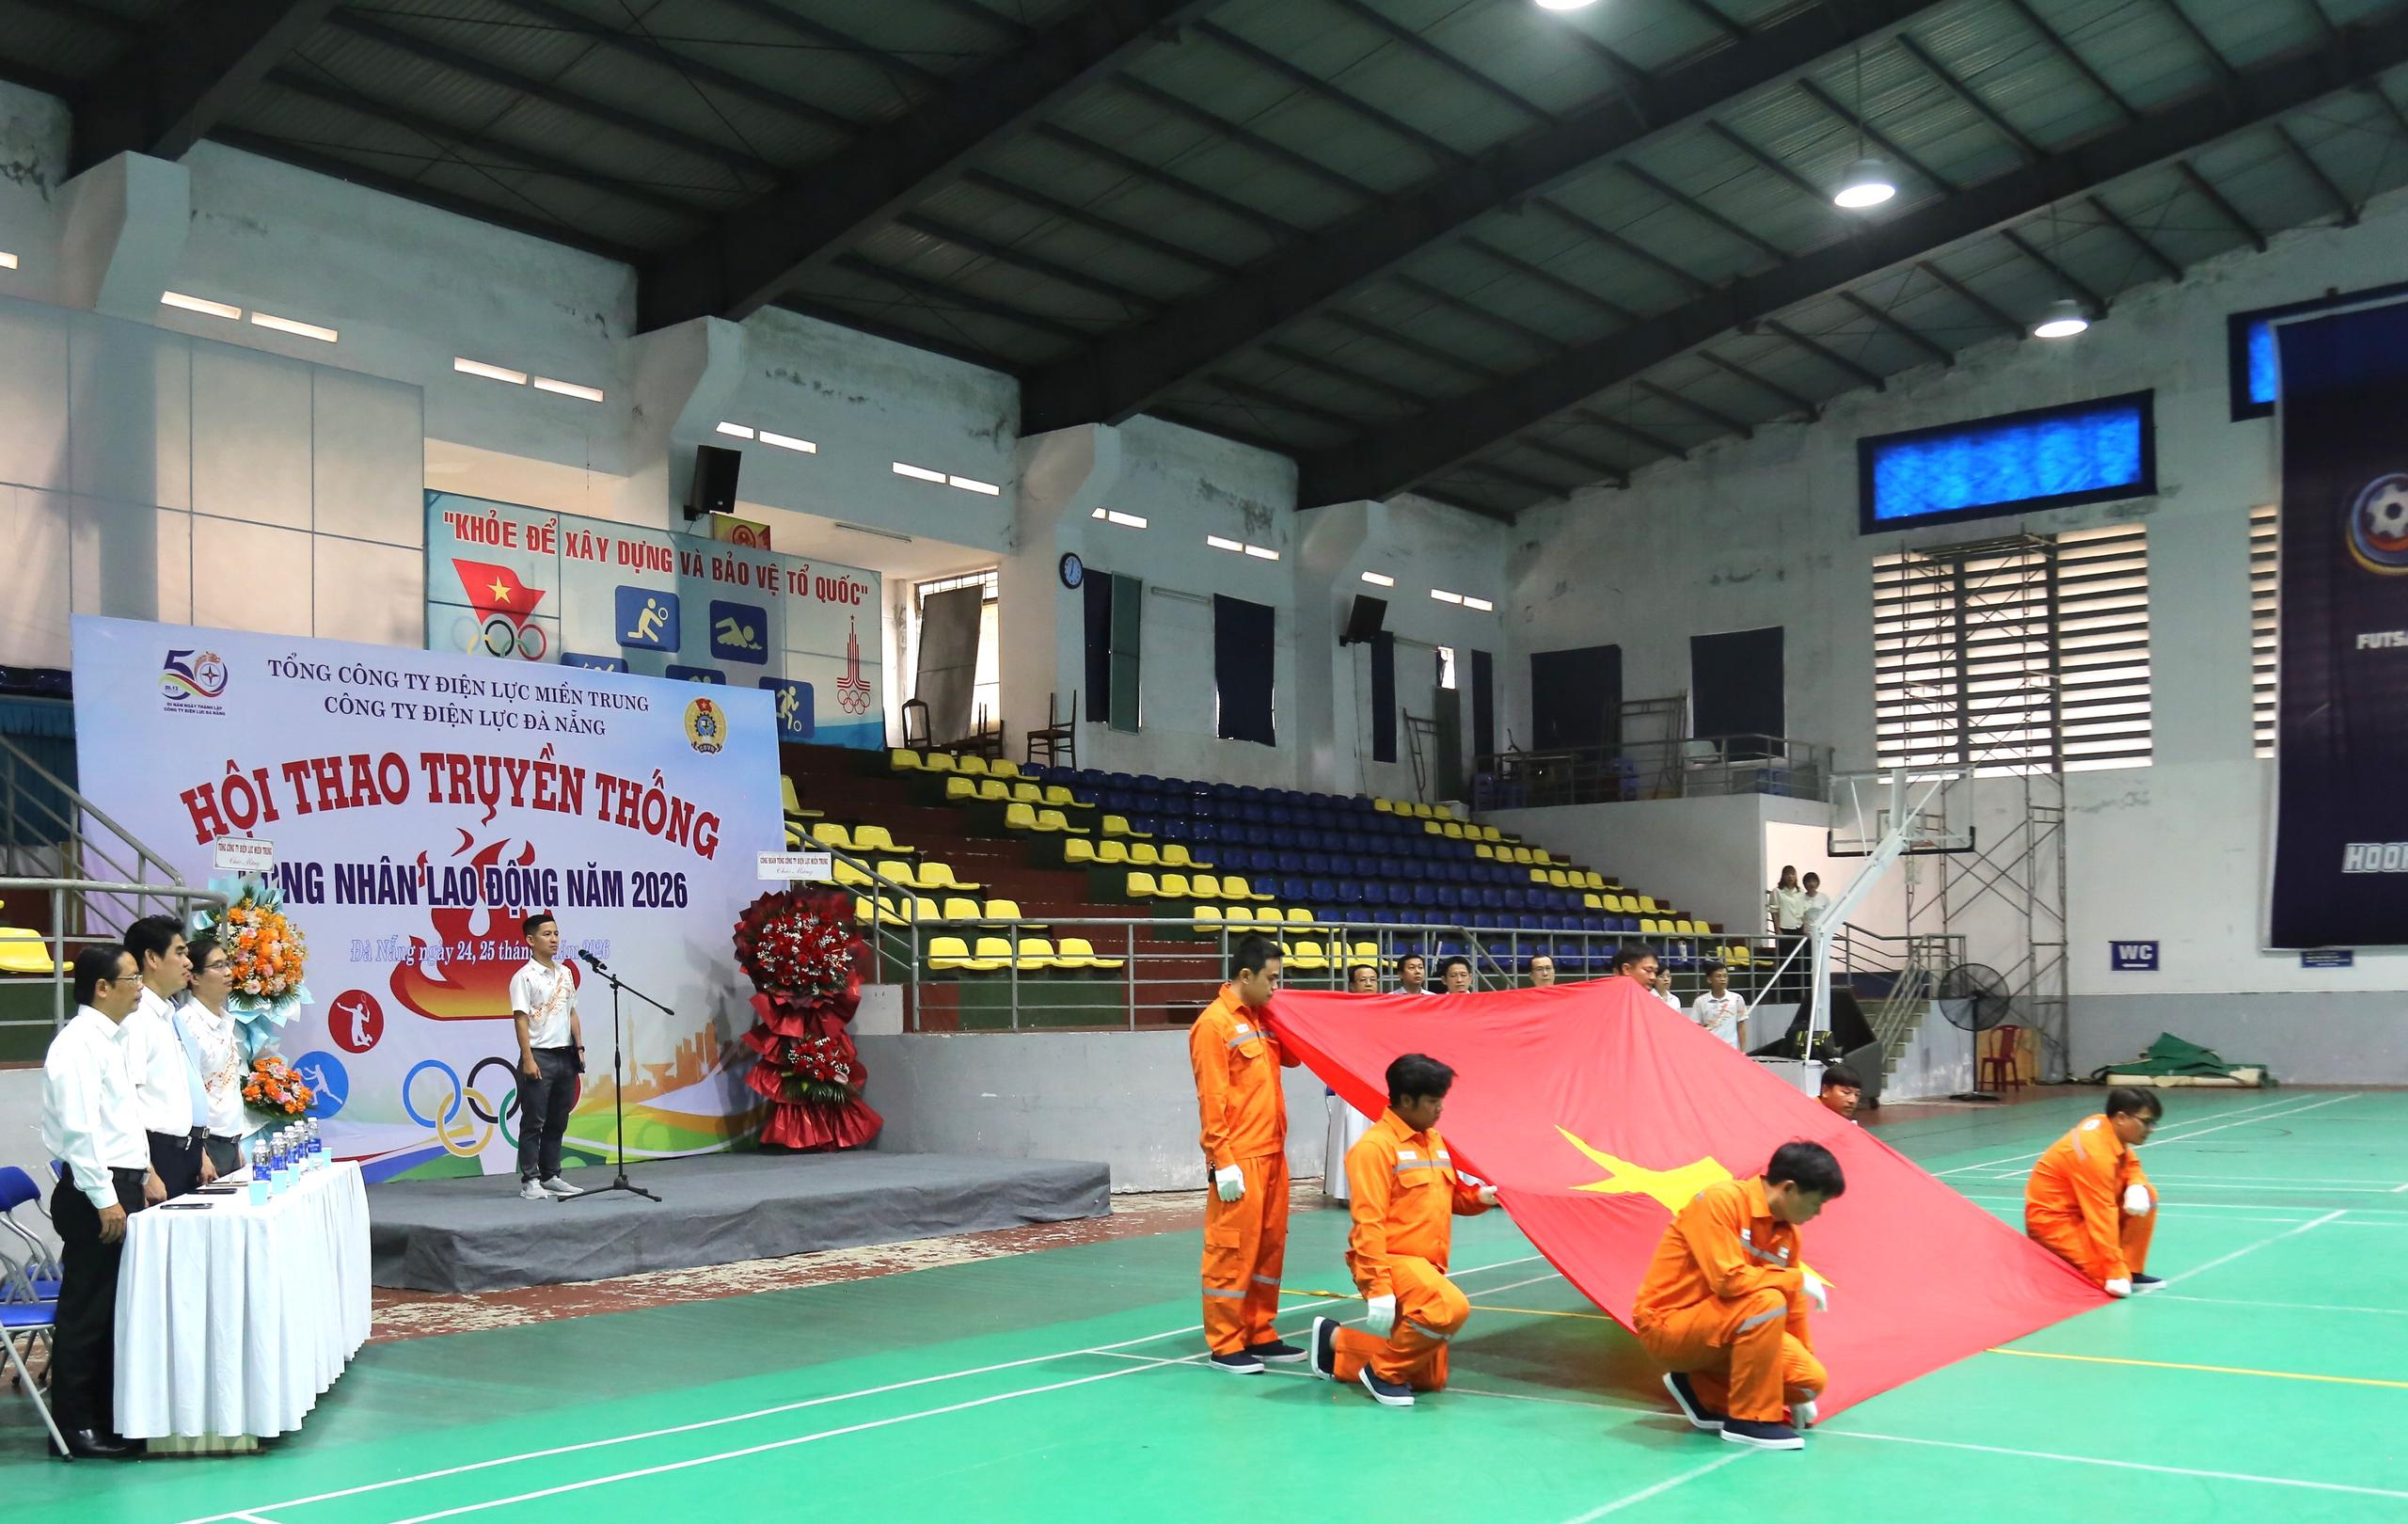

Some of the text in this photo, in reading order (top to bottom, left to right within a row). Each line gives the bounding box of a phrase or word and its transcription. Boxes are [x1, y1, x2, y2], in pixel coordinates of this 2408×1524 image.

[444, 509, 868, 606] "KHỎE ĐỂ XÂY DỰNG VÀ BẢO VỆ TỔ QUỐC"
[267, 652, 649, 712] TỔNG CÔNG TY ĐIỆN LỰC MIỀN TRUNG
[324, 691, 606, 736] CÔNG TY ĐIỆN LỰC ĐÀ NẴNG
[180, 742, 721, 861] HỘI THAO TRUYỀN THỐNG
[334, 854, 419, 905] NHÂN
[426, 865, 479, 906] LAO
[485, 859, 559, 916] ĐỘNG
[566, 861, 625, 908] NĂM
[631, 871, 689, 909] 2026
[350, 939, 372, 962] Đà
[376, 934, 416, 966] Nẵng
[419, 942, 454, 966] ngày
[456, 940, 476, 965] 24,
[479, 940, 496, 960] 25
[2117, 945, 2153, 960] WC
